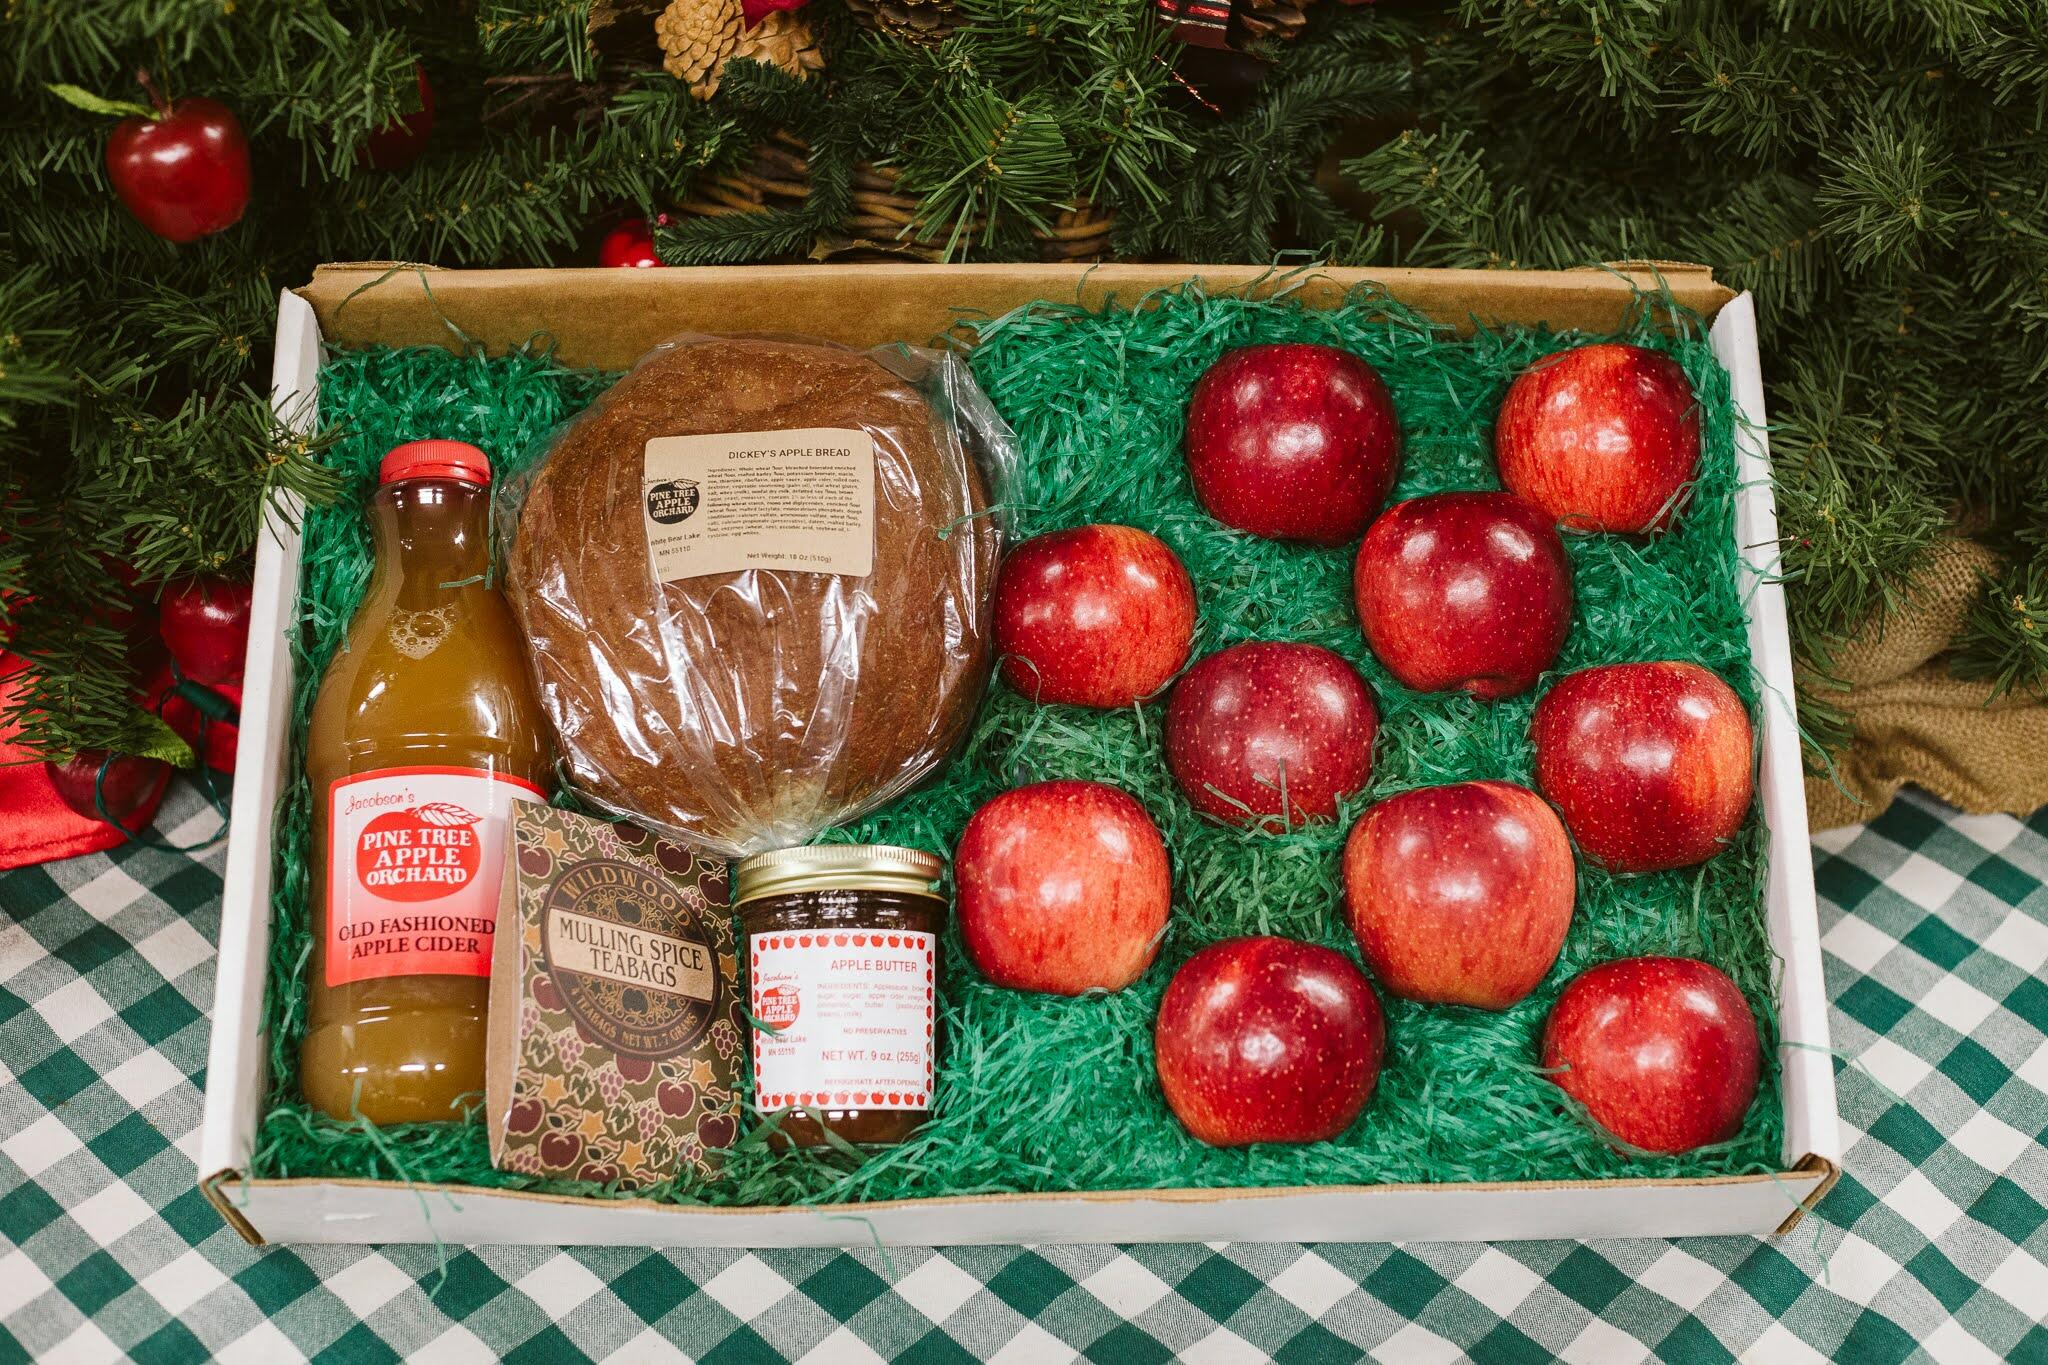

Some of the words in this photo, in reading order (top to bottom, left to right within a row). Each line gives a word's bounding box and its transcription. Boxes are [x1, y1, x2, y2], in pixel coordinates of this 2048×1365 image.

[728, 450, 776, 459] DICKEY'S
[779, 449, 813, 457] APPLE
[816, 448, 851, 457] BREAD
[650, 490, 671, 502] PINE
[673, 489, 696, 498] TREE
[656, 497, 691, 509] APPLE
[652, 506, 694, 518] ORCHARD
[345, 788, 414, 815] Jacobson's
[363, 829, 412, 850] PINE
[418, 828, 472, 847] TREE
[374, 848, 460, 868] APPLE
[366, 867, 467, 886] ORCHARD
[561, 866, 690, 926] WILDWOOD
[339, 921, 374, 941] OLD
[380, 916, 496, 935] FASHIONED
[351, 937, 409, 959] APPLE
[415, 936, 481, 954] CIDER
[559, 917, 643, 957] MULLING
[650, 939, 704, 971] SPICE
[590, 948, 677, 987] TEABAGS
[831, 960, 871, 970] APPLE
[876, 960, 917, 972] BUTTER
[576, 998, 617, 1038] TEABAGS
[669, 1012, 697, 1041] GRAMS
[766, 1005, 793, 1014] APPLE
[822, 1051, 843, 1060] NET
[848, 1051, 867, 1060] WT.
[871, 1051, 877, 1060] 9
[897, 1052, 920, 1064] (255g)
